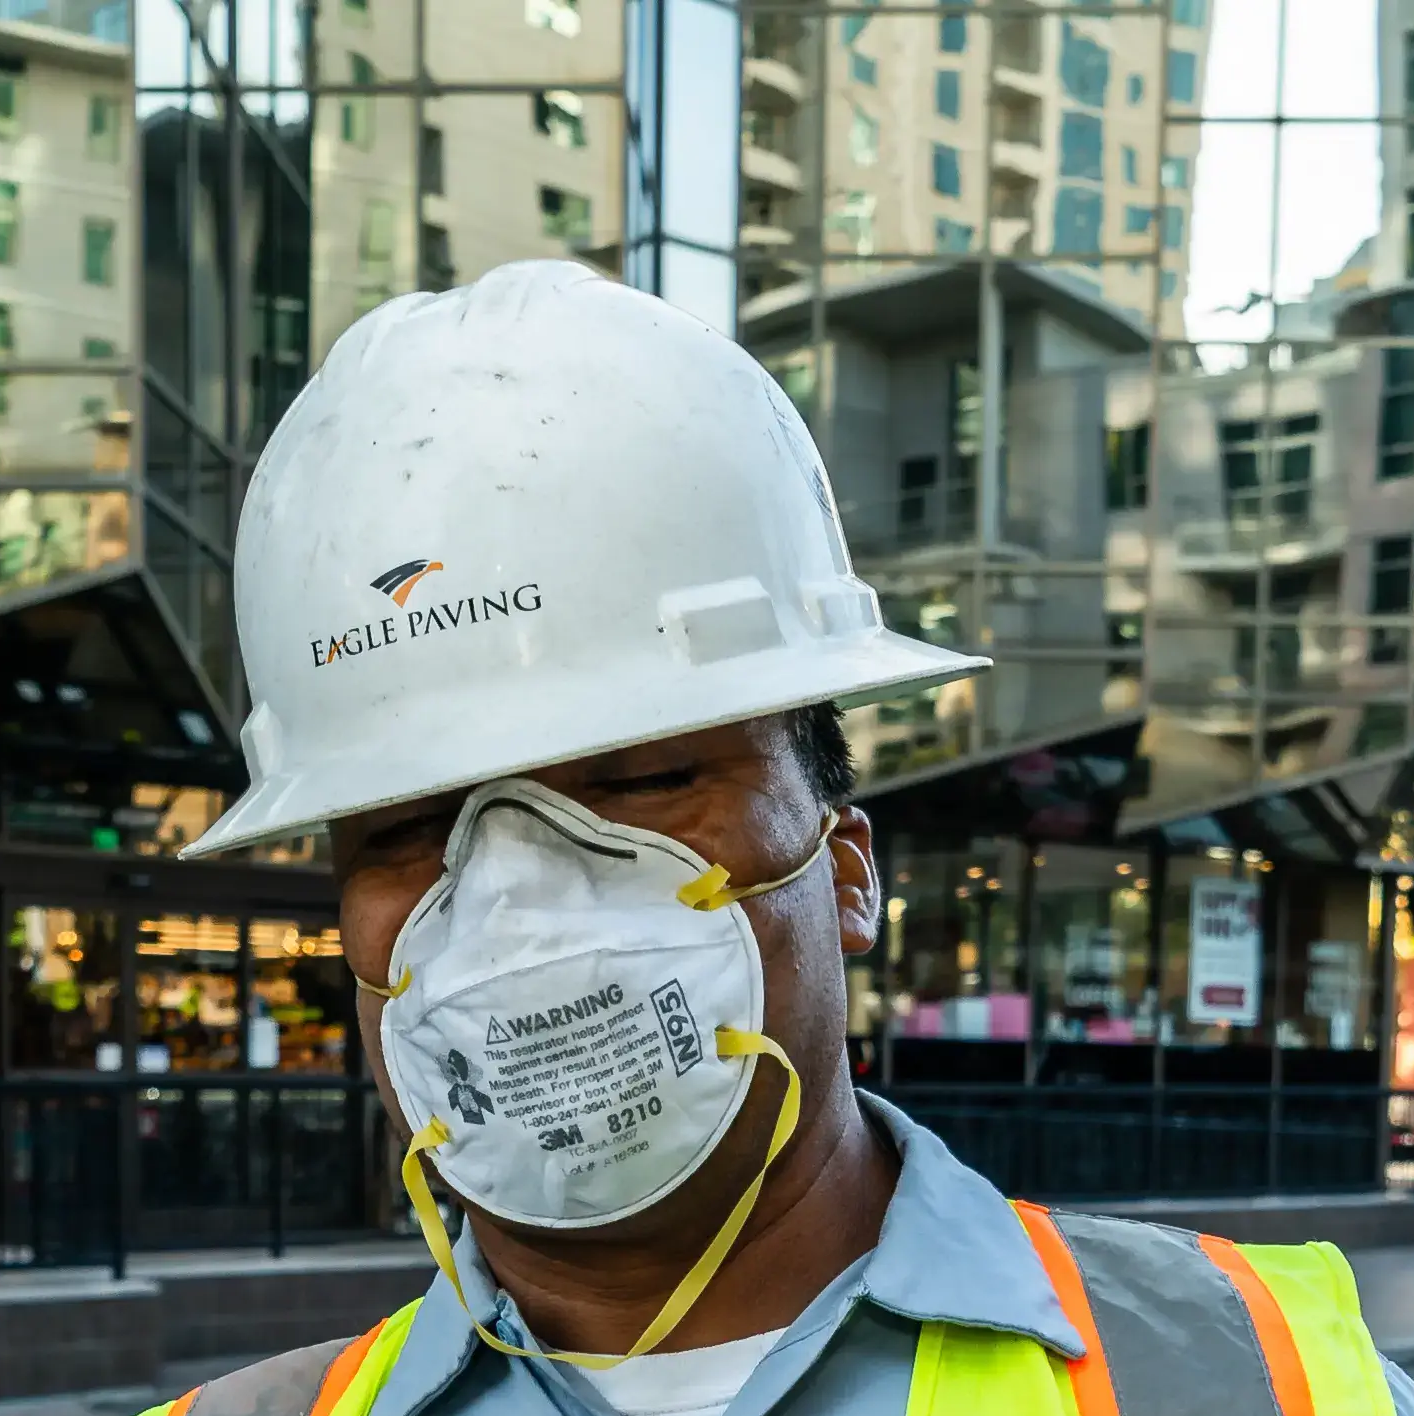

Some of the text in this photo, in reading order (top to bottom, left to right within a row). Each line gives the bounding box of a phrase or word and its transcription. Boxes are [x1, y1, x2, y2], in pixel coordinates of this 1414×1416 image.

[309, 583, 542, 668] EAGLE PAVING
[483, 1003, 644, 1061] This respirator helps protect
[507, 983, 624, 1038] WARNING
[658, 991, 699, 1064] N95
[488, 1030, 659, 1091] Misuse may result in sickness
[496, 1095, 509, 1104] or
[550, 1080, 571, 1093] For
[574, 1067, 614, 1088] proper
[643, 1046, 661, 1061] see
[498, 1057, 542, 1076] against
[544, 1043, 588, 1064] certain
[503, 1059, 663, 1118] supervisor or box or call 3M
[619, 1078, 657, 1102] NIOSH
[537, 1096, 663, 1151] 3M 8210
[561, 1164, 583, 1178] Lot
[587, 1161, 596, 1172] #
